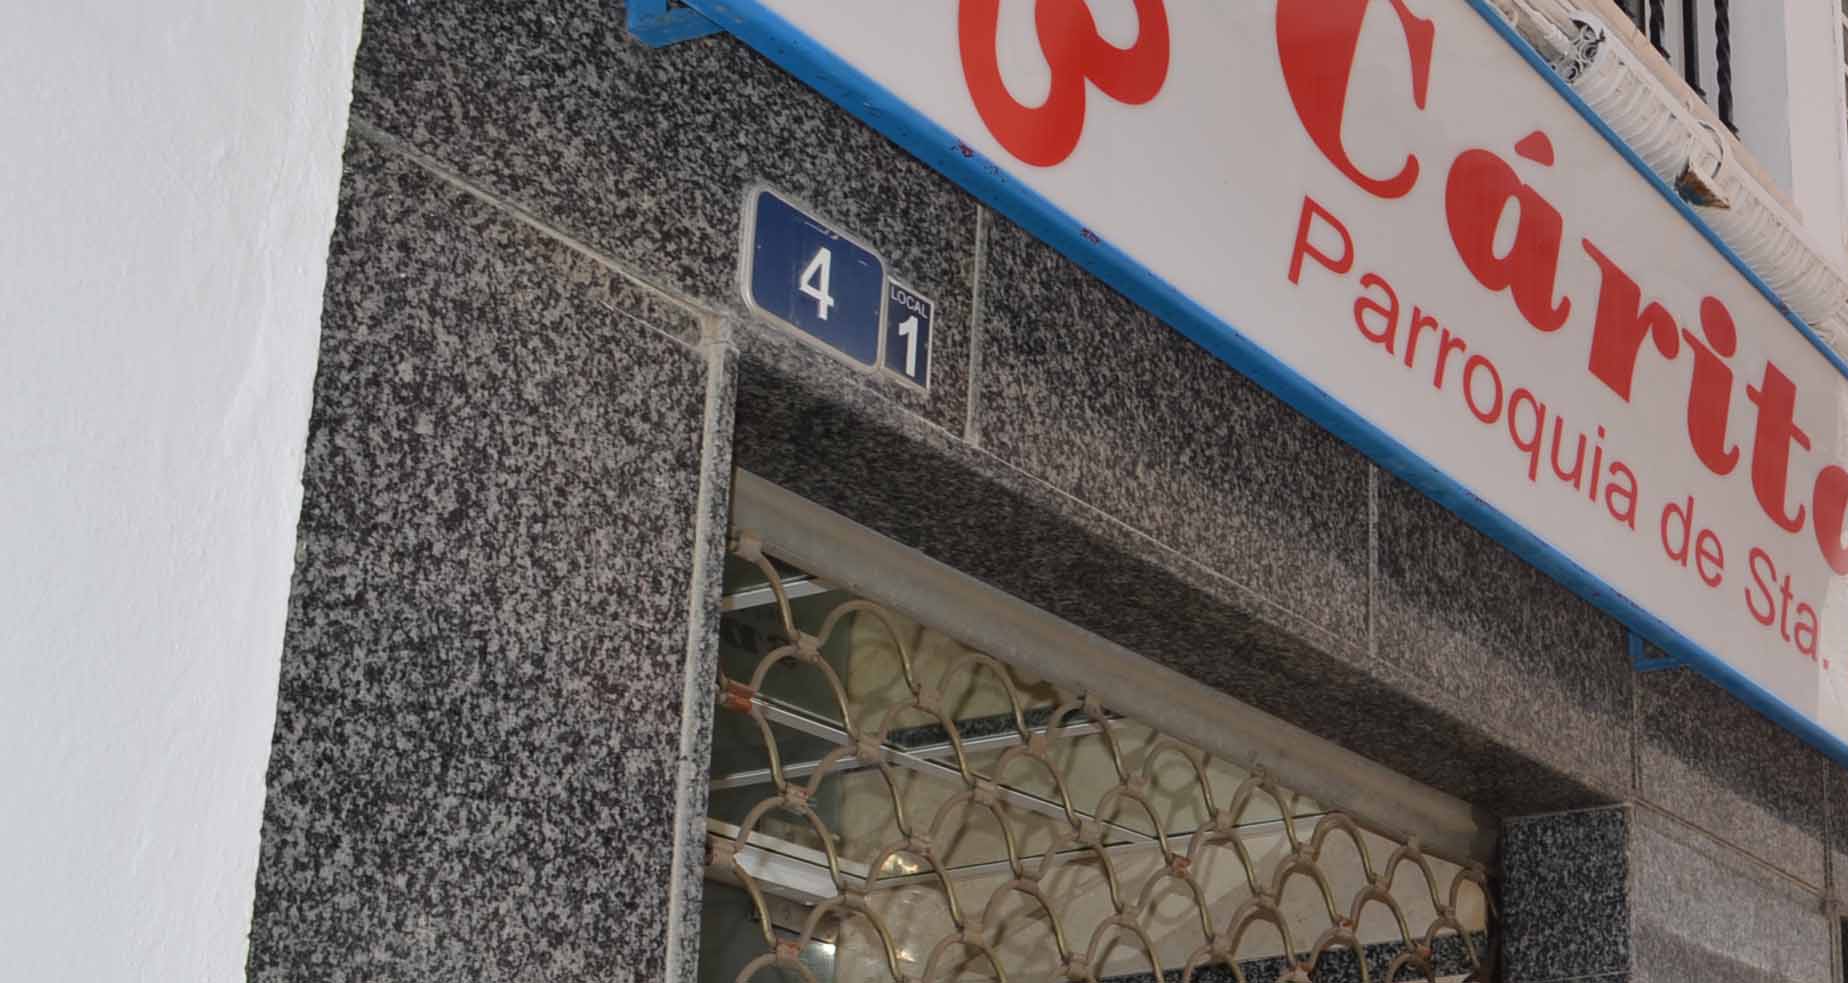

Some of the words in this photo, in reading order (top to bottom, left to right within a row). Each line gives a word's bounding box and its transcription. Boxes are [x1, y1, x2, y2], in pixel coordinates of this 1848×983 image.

[799, 247, 834, 320] 4
[891, 286, 928, 319] LOCAL
[898, 315, 919, 377] 1
[1287, 194, 1640, 534] Parroquia
[1659, 495, 1727, 590] de
[1744, 544, 1831, 670] Sta.
